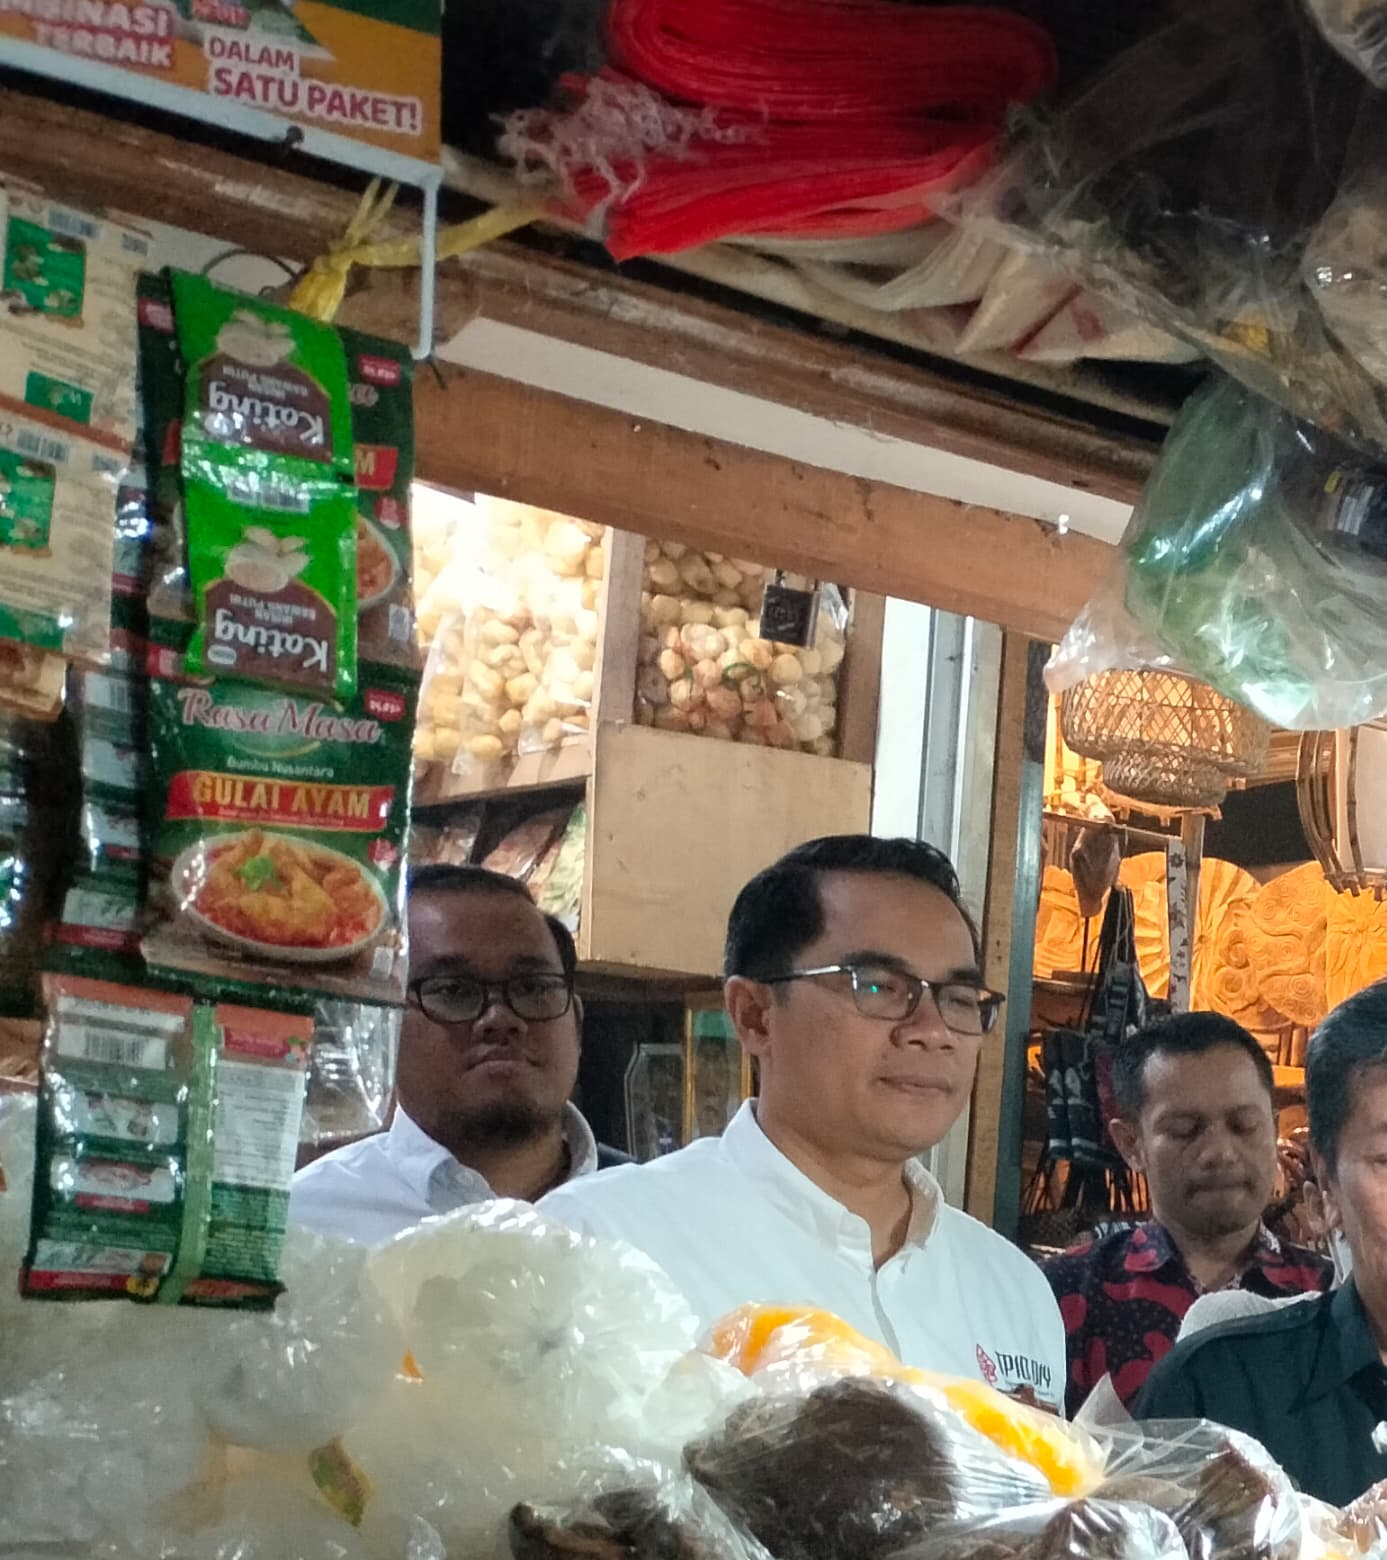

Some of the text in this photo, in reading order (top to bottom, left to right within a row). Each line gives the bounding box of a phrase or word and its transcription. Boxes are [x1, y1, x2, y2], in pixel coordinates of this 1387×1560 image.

[35, 20, 172, 67] TERBAIK
[209, 36, 295, 71] DALAM
[213, 67, 418, 131] SATU PAKET!
[209, 380, 324, 446] Kating
[214, 607, 328, 672] Kating
[177, 687, 271, 735] Rasa
[276, 696, 382, 745] Masa
[192, 771, 282, 809] GULAI
[291, 783, 371, 819] AYAM
